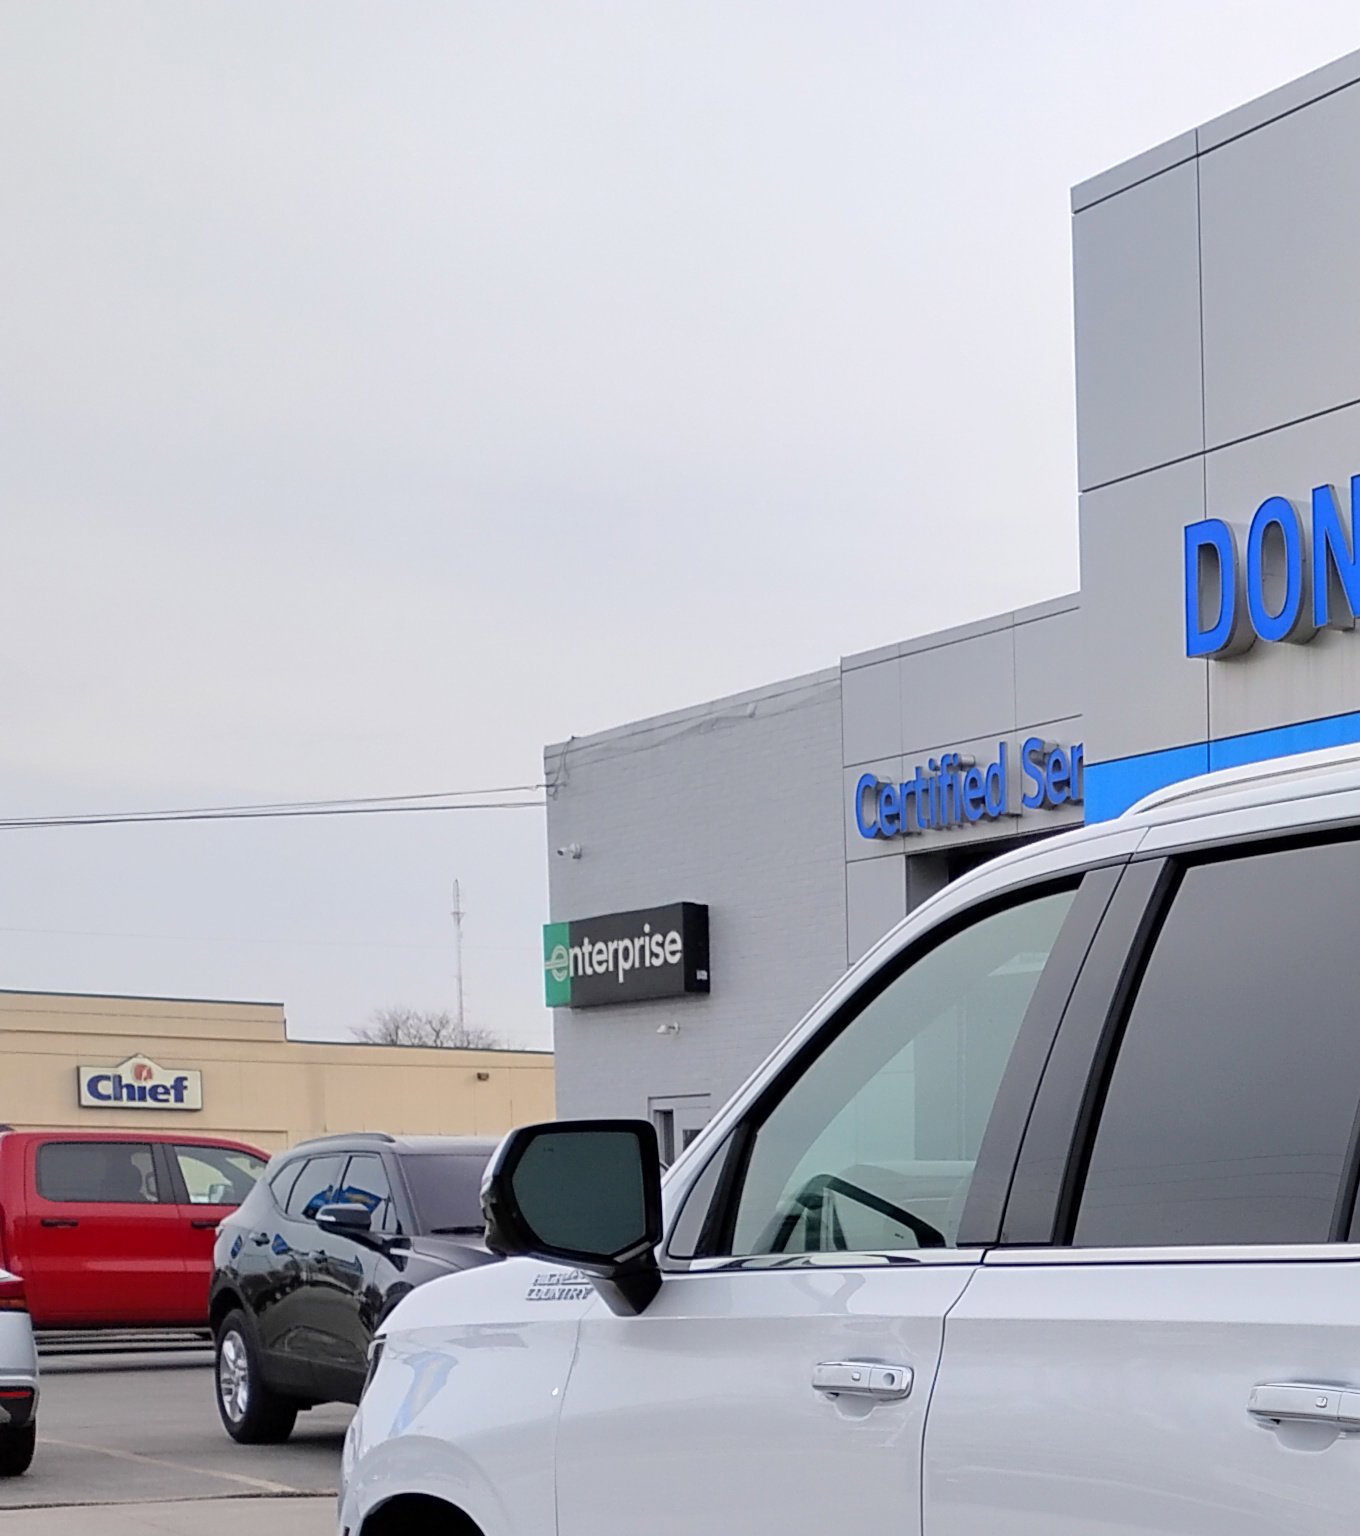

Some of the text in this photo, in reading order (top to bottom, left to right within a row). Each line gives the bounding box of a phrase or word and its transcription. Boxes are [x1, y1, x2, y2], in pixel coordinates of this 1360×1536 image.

[856, 741, 1010, 838] Certified
[545, 923, 683, 983] enterprise
[87, 1074, 188, 1103] Chief
